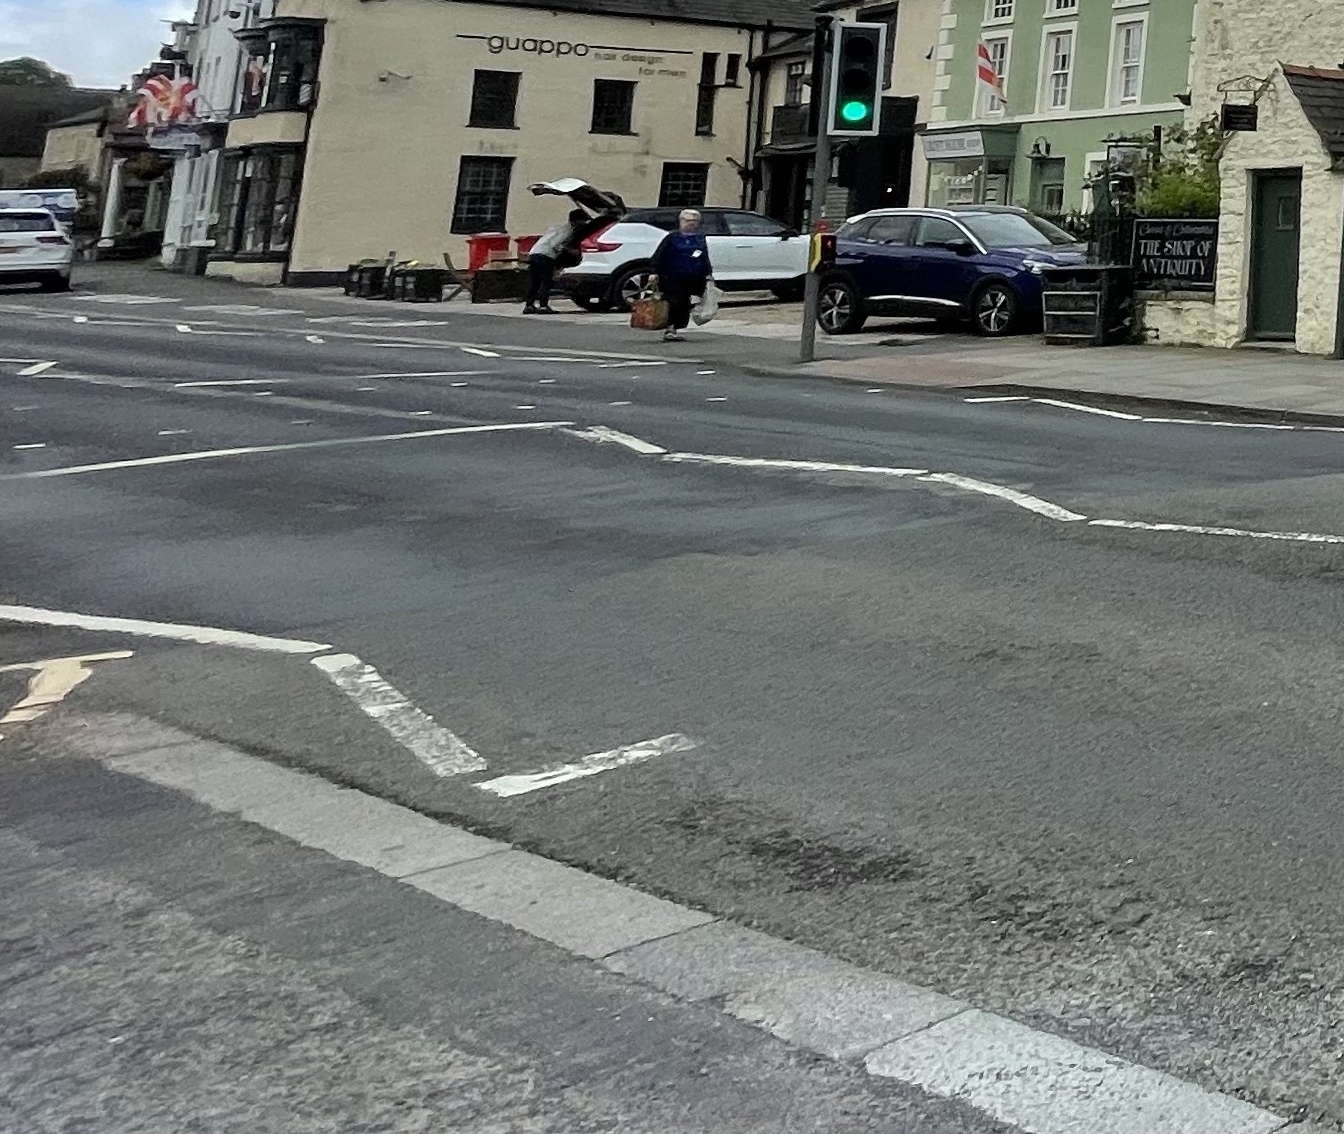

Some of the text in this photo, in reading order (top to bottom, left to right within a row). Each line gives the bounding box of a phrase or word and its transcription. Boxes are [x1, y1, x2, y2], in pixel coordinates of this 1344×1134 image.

[487, 35, 589, 58] guappo
[1139, 239, 1213, 257] THE SHOP OF
[1143, 258, 1205, 277] ANTIQUITY
